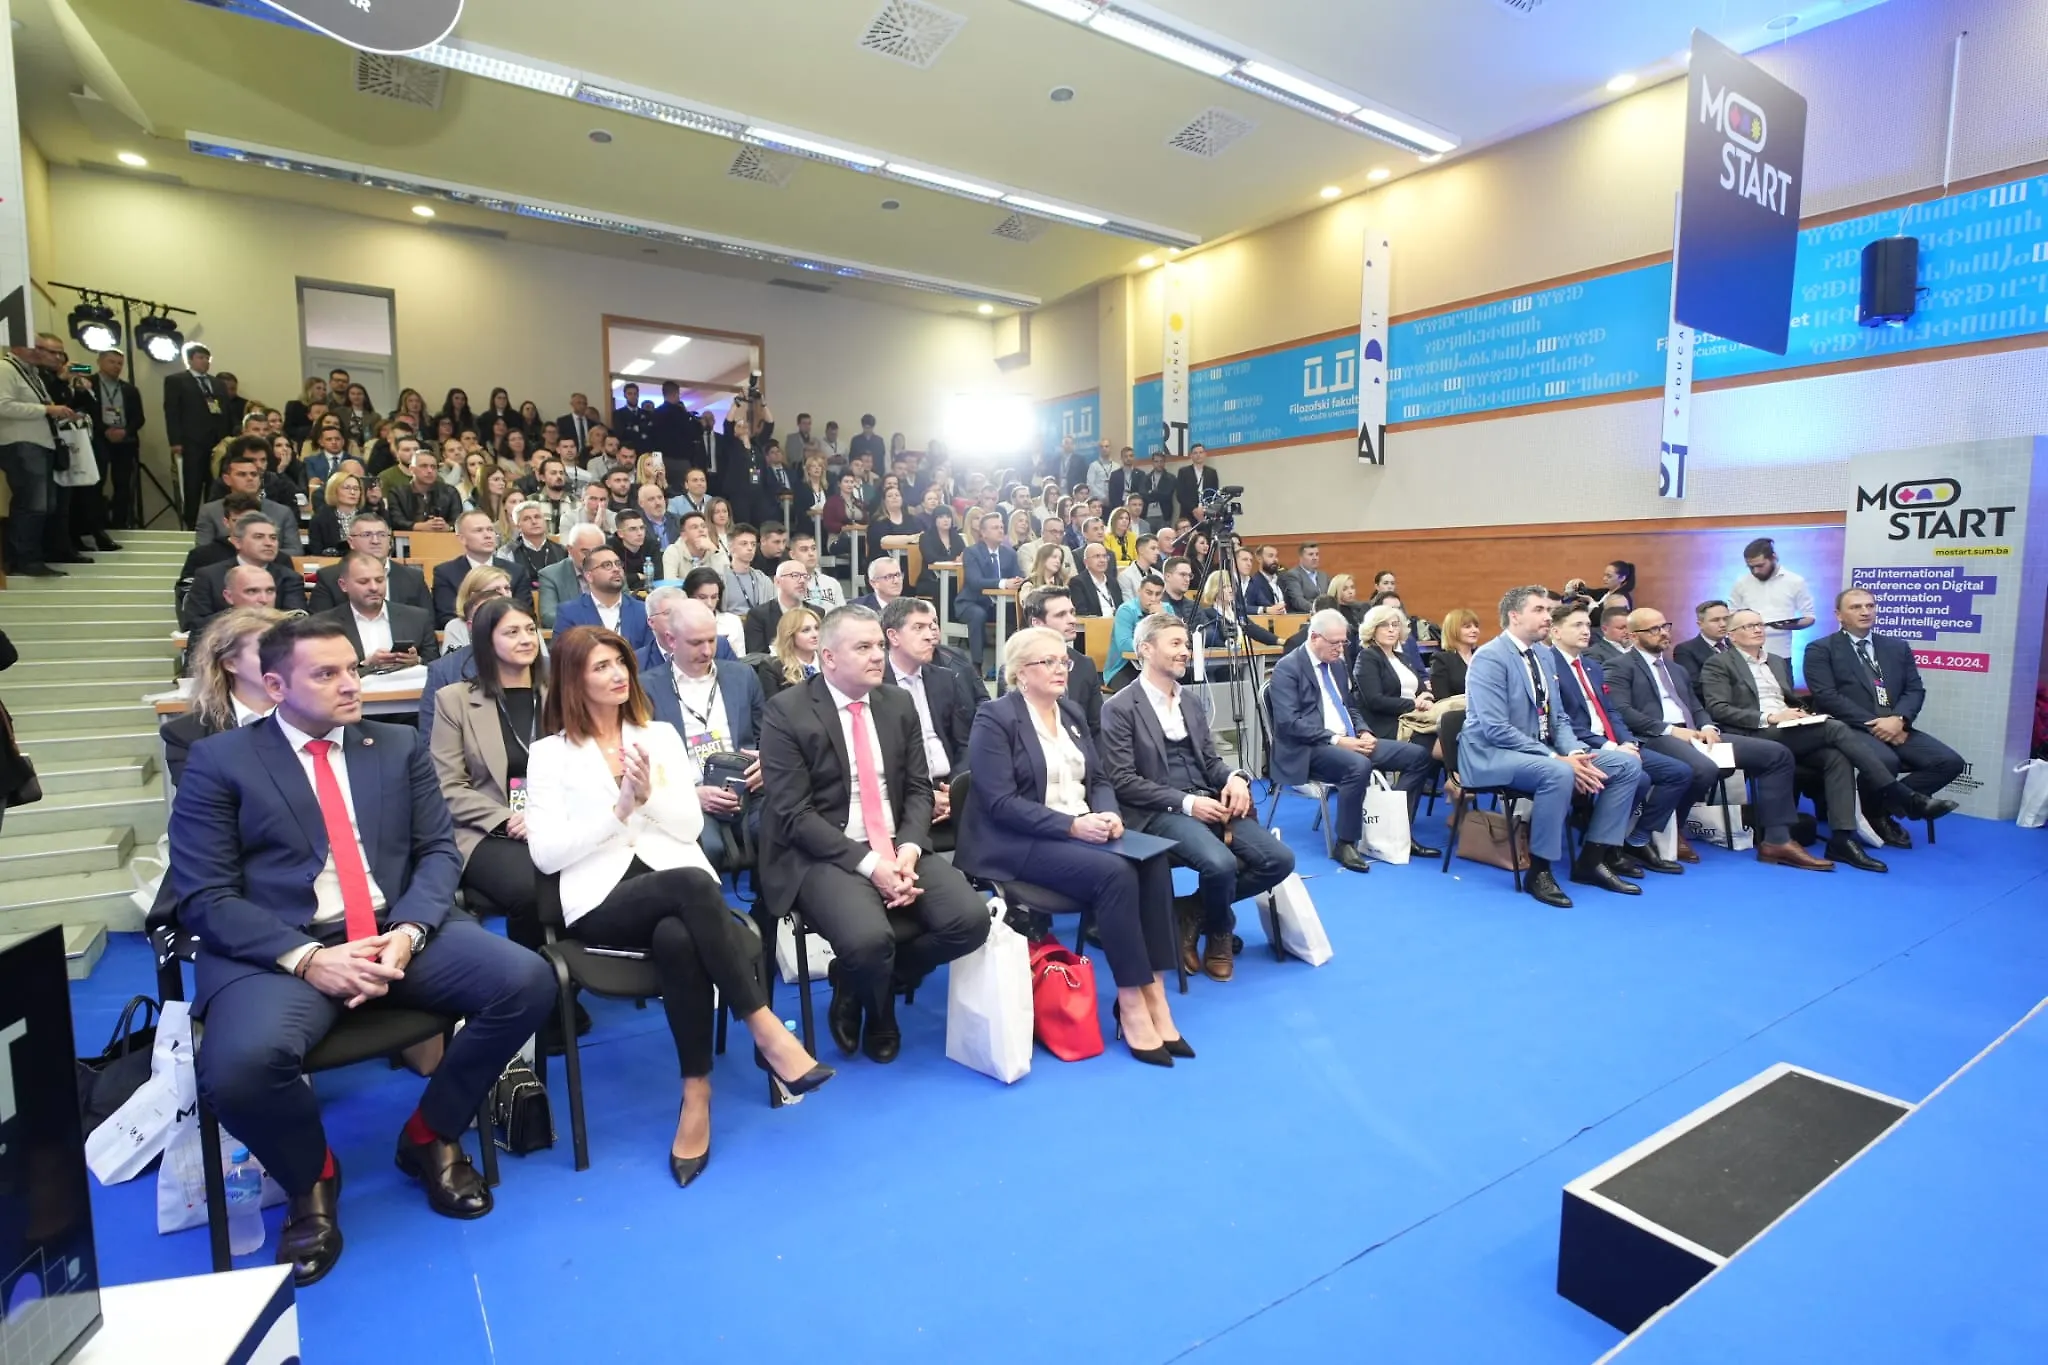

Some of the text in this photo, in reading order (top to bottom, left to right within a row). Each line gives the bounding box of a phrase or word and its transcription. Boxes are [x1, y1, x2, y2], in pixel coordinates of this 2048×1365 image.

[1720, 142, 1792, 216] START
[1289, 398, 1331, 415] Filozofski
[1888, 506, 2016, 541] START
[1935, 546, 2009, 557] mostart.sum.ba
[1854, 568, 1954, 578] 2nd International
[1853, 580, 1921, 590] Conference
[1942, 581, 1983, 592] Digital
[1925, 605, 1949, 615] and
[1901, 616, 1973, 629] Intelligence
[693, 740, 722, 756] PART
